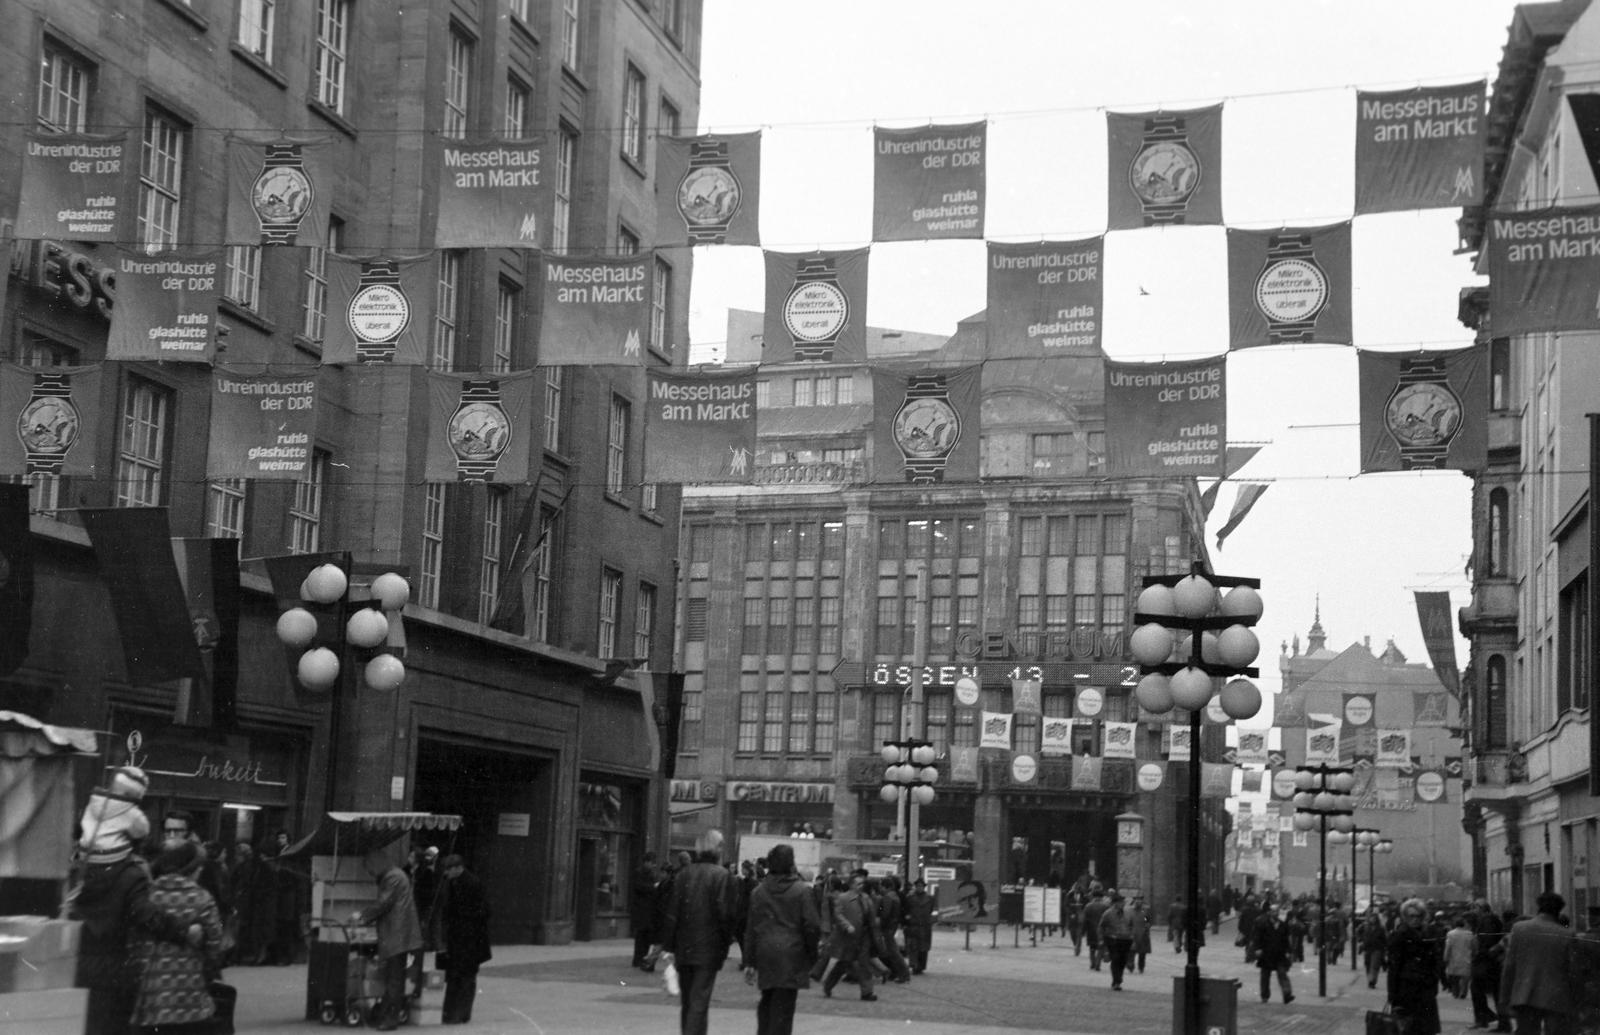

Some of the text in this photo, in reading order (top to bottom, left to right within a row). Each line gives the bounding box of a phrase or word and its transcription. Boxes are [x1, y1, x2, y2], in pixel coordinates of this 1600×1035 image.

[1363, 95, 1477, 121] Messehaus
[1374, 115, 1477, 142] am Markt
[28, 142, 121, 157] Uhrenindustrie
[878, 136, 981, 156] Uhrenindustrie
[444, 148, 539, 167] Messehaus
[922, 151, 980, 168] der DDR
[69, 160, 120, 173] der DDR
[456, 169, 539, 187] am Markt
[86, 196, 115, 207] ruhla
[942, 190, 977, 202] ruhla
[58, 209, 115, 222] glashütte
[913, 205, 978, 222] glashütte
[69, 222, 113, 232] weimar
[927, 219, 978, 230] weimar
[1508, 243, 1543, 262] am
[121, 259, 216, 275] Uhrenindustrie
[993, 251, 1098, 271] Uhrenindustrie
[548, 264, 645, 283] Messehaus
[1038, 267, 1097, 284] der DDR
[1277, 269, 1304, 279] Mikro
[162, 277, 214, 290] der DDR
[1267, 279, 1313, 289] elektronik
[368, 293, 390, 302] Mikro
[558, 285, 644, 303] am Markt
[804, 290, 828, 300] Mikro
[358, 302, 397, 311] elektronik
[794, 300, 834, 310] elektronik
[1275, 299, 1307, 309] überall
[1058, 305, 1094, 318] ruhla
[177, 313, 208, 324] ruhla
[801, 319, 829, 329] überall
[364, 321, 391, 330] überall
[1028, 320, 1096, 338] glashütte
[149, 327, 207, 339] glashütte
[161, 340, 206, 350] weimar
[1043, 335, 1096, 347] weimar
[1110, 368, 1220, 389] Uhrenindustrie
[218, 379, 314, 396] Uhrenindustrie
[652, 381, 750, 400] Messehaus
[1158, 382, 1220, 402] der DDR
[261, 397, 313, 410] der DDR
[662, 402, 750, 420] am Markt
[1180, 423, 1218, 437] ruhla
[277, 433, 308, 444] ruhla
[248, 447, 307, 460] glashütte
[1148, 439, 1219, 456] glashütte
[259, 460, 306, 470] weimar
[1163, 453, 1219, 465] weimar
[956, 631, 1125, 658] CENTRUM
[733, 782, 831, 803] CENTRUM
